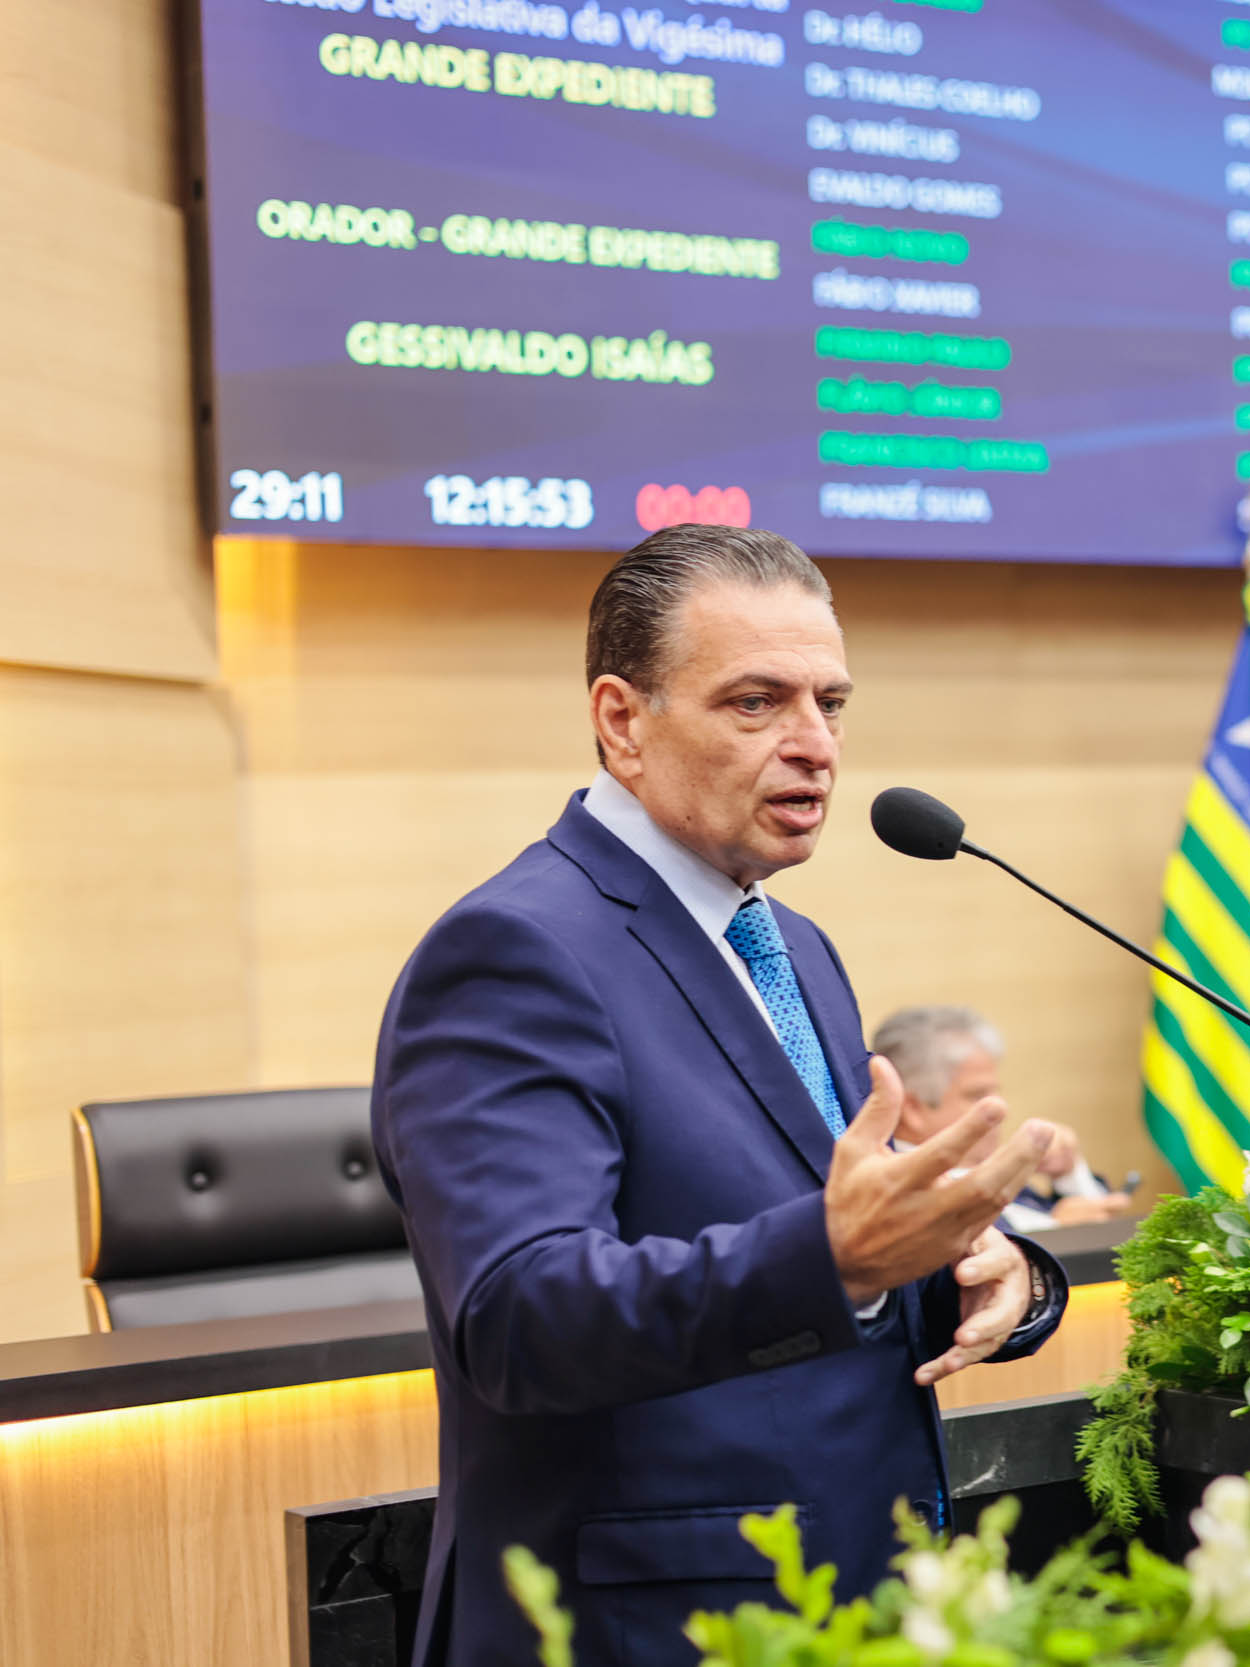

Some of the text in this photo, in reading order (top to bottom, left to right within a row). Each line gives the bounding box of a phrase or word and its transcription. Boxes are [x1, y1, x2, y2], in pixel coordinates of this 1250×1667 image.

[572, 3, 619, 44] da
[623, 10, 783, 65] Vigésima
[804, 9, 923, 56] Dr. HÉLIO
[320, 34, 716, 117] GRANDE EXPEDIENTE
[805, 62, 1041, 121] Dr. THALES COELHO
[807, 115, 959, 162] Dr. VINÍCIUS
[809, 168, 1001, 218] EVALDO GOMES
[258, 199, 414, 248] ORADOR
[442, 215, 585, 262] GRANDE
[590, 227, 777, 278] EXPEDIENTE
[347, 322, 714, 386] GESSIVALDO ISAÍAS
[232, 470, 341, 520] 29:11
[426, 476, 592, 527] 12:15:53
